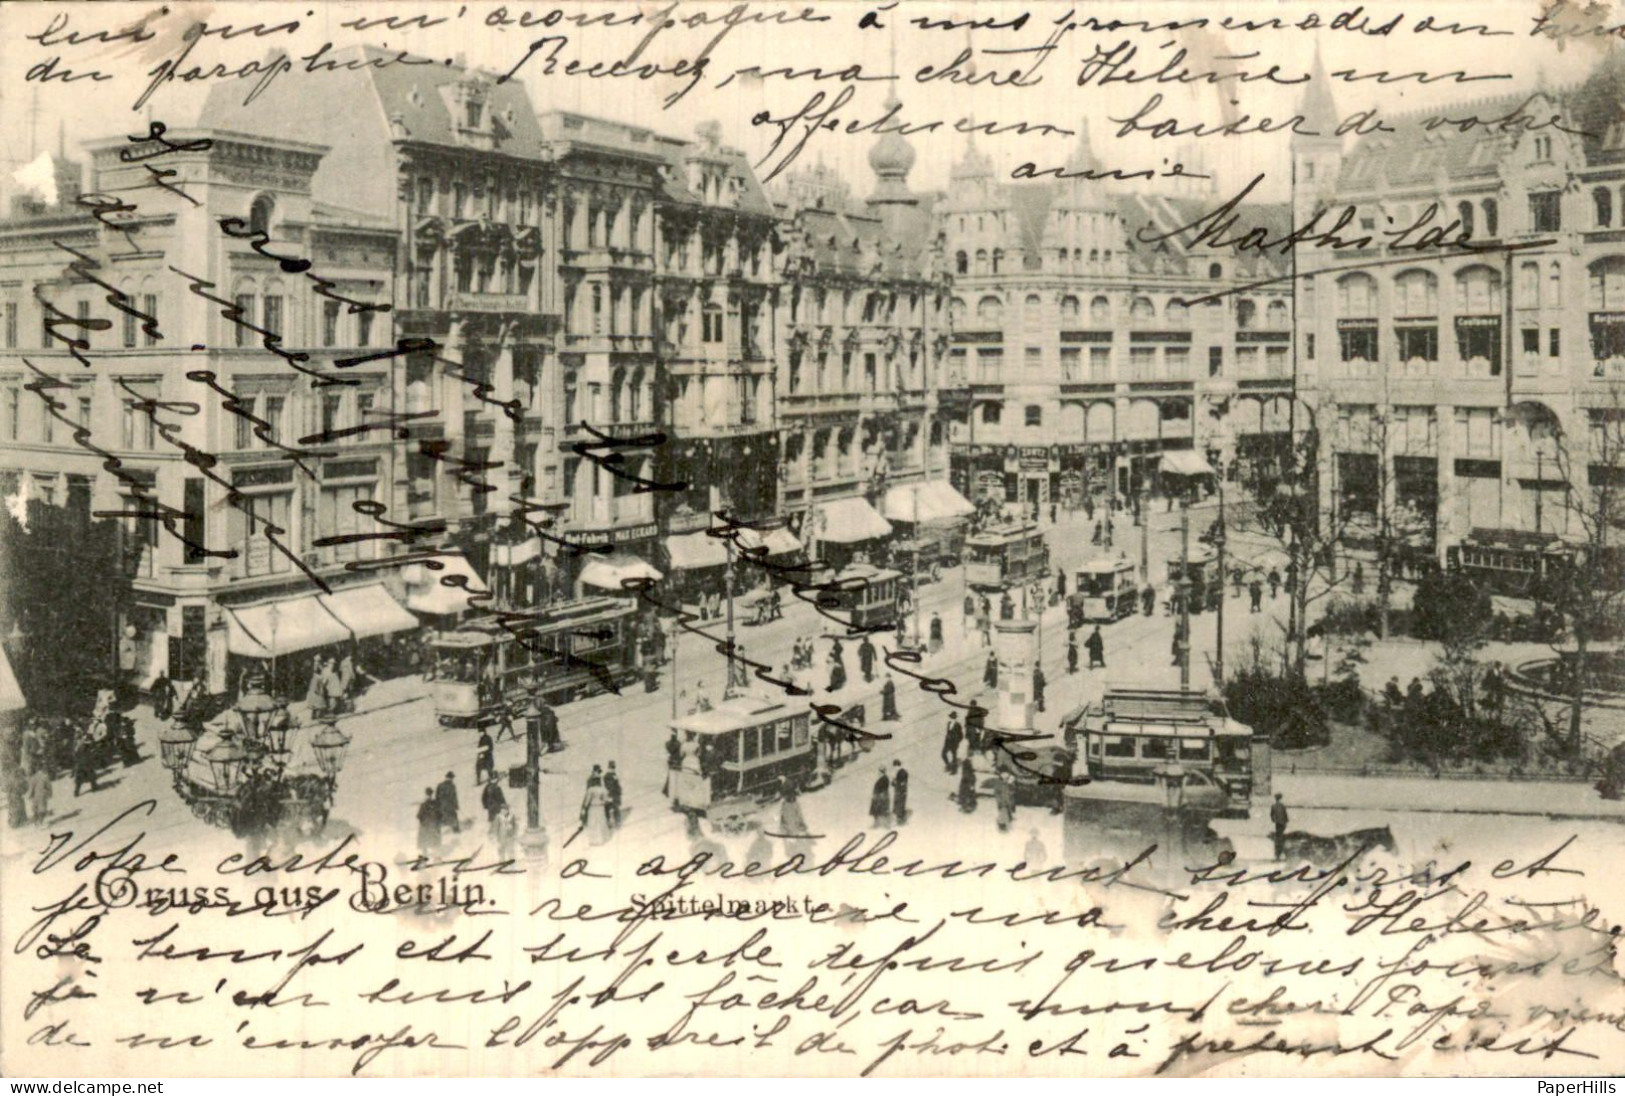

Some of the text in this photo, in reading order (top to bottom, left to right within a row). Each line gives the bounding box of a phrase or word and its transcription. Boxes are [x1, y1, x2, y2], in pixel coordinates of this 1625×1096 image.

[1335, 108, 1396, 137] de
[1421, 93, 1600, 138] votre
[1137, 174, 1558, 256] Mathilde
[217, 834, 366, 875] carte
[1492, 834, 1584, 879] et
[133, 923, 364, 1004] temps
[396, 929, 493, 964] est
[26, 1021, 91, 1047] de
[1028, 1028, 1088, 1056] et
